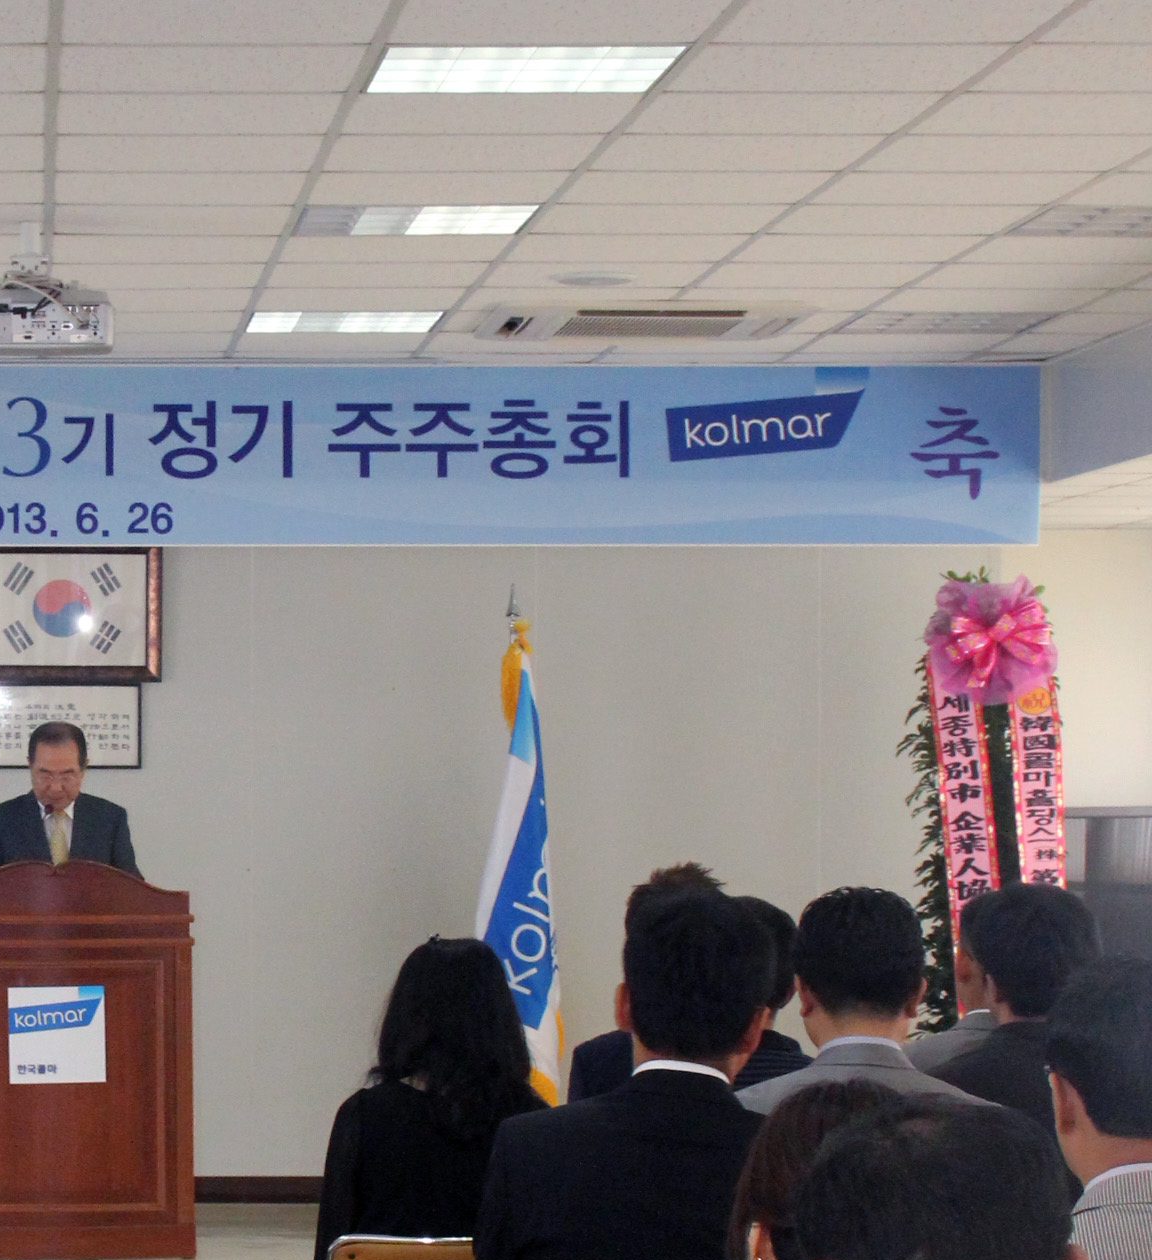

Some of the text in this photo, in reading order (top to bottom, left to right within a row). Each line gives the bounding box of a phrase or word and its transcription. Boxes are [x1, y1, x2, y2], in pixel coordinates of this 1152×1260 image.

[147, 399, 294, 480] 정기
[327, 399, 630, 480] 주주총회
[684, 408, 832, 449] kolmar
[910, 406, 1001, 499] 축
[75, 502, 110, 537] 6.
[127, 502, 173, 535] 26
[13, 1007, 88, 1029] kolmar
